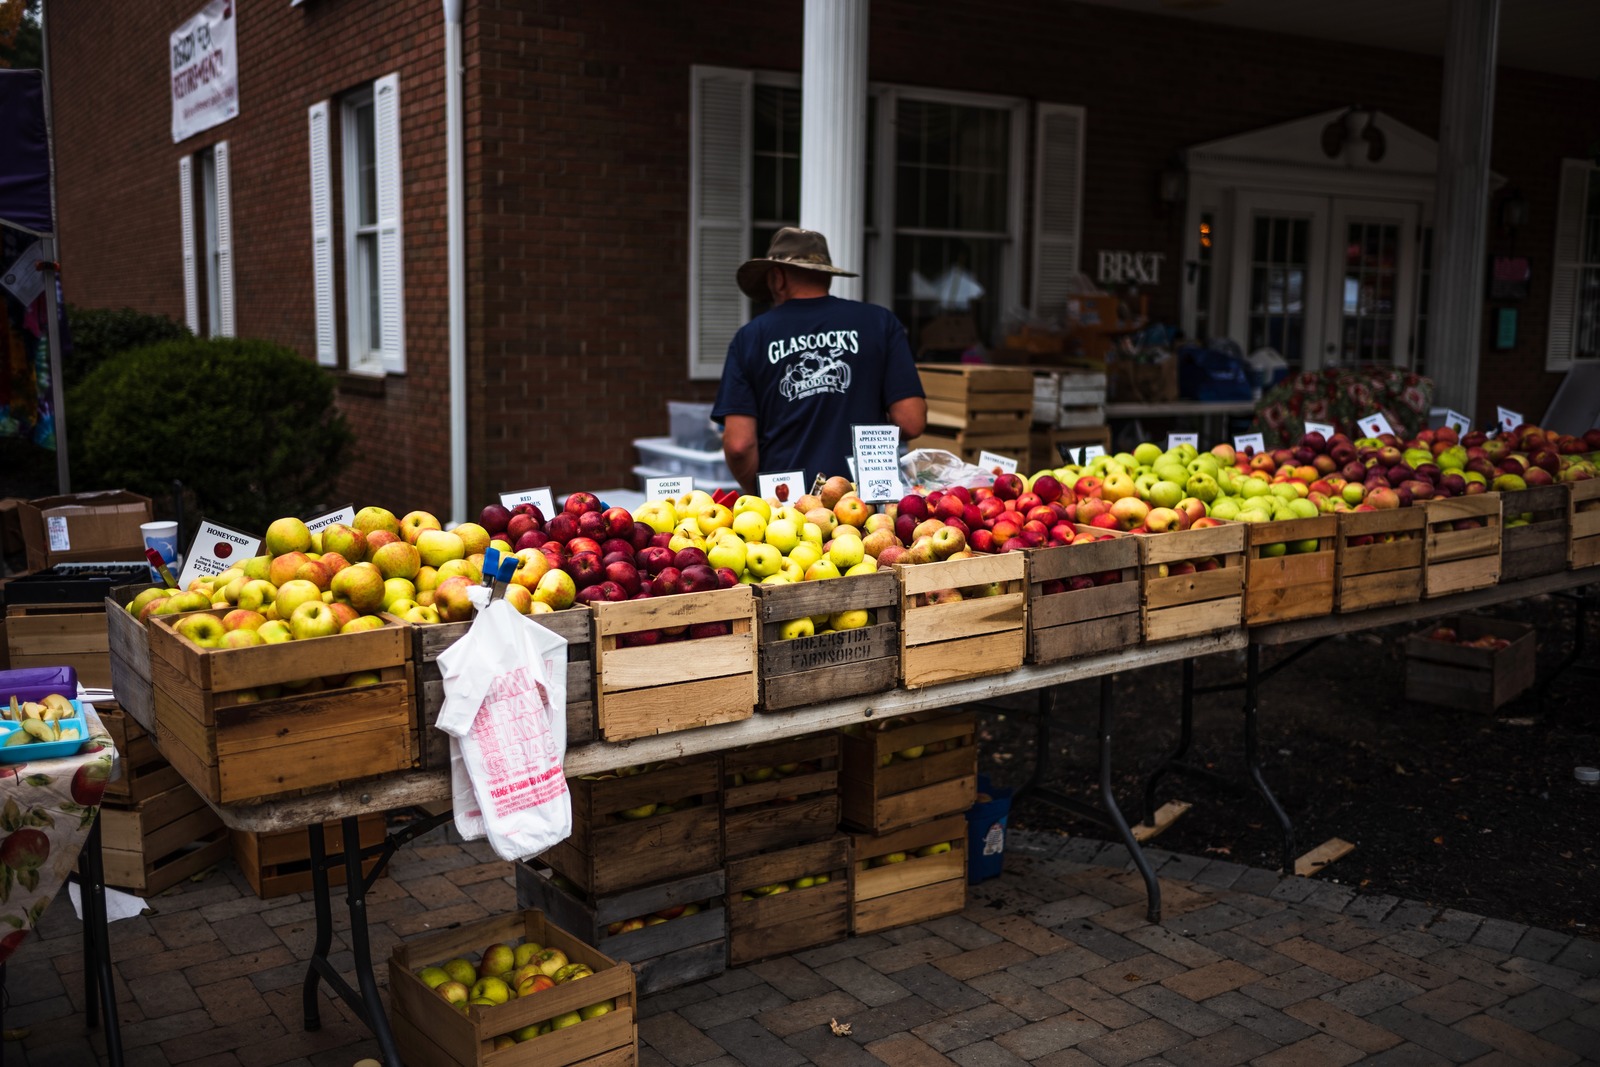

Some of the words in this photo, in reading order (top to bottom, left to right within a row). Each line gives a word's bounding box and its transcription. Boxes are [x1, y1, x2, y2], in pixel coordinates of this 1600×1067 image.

[1097, 250, 1167, 284] BB&T
[768, 330, 859, 364] GLASCOCK'S
[206, 527, 250, 547] HONEYCRISP
[193, 563, 211, 573] $2.50
[490, 785, 508, 799] PLEASE
[508, 779, 529, 792] RETURN
